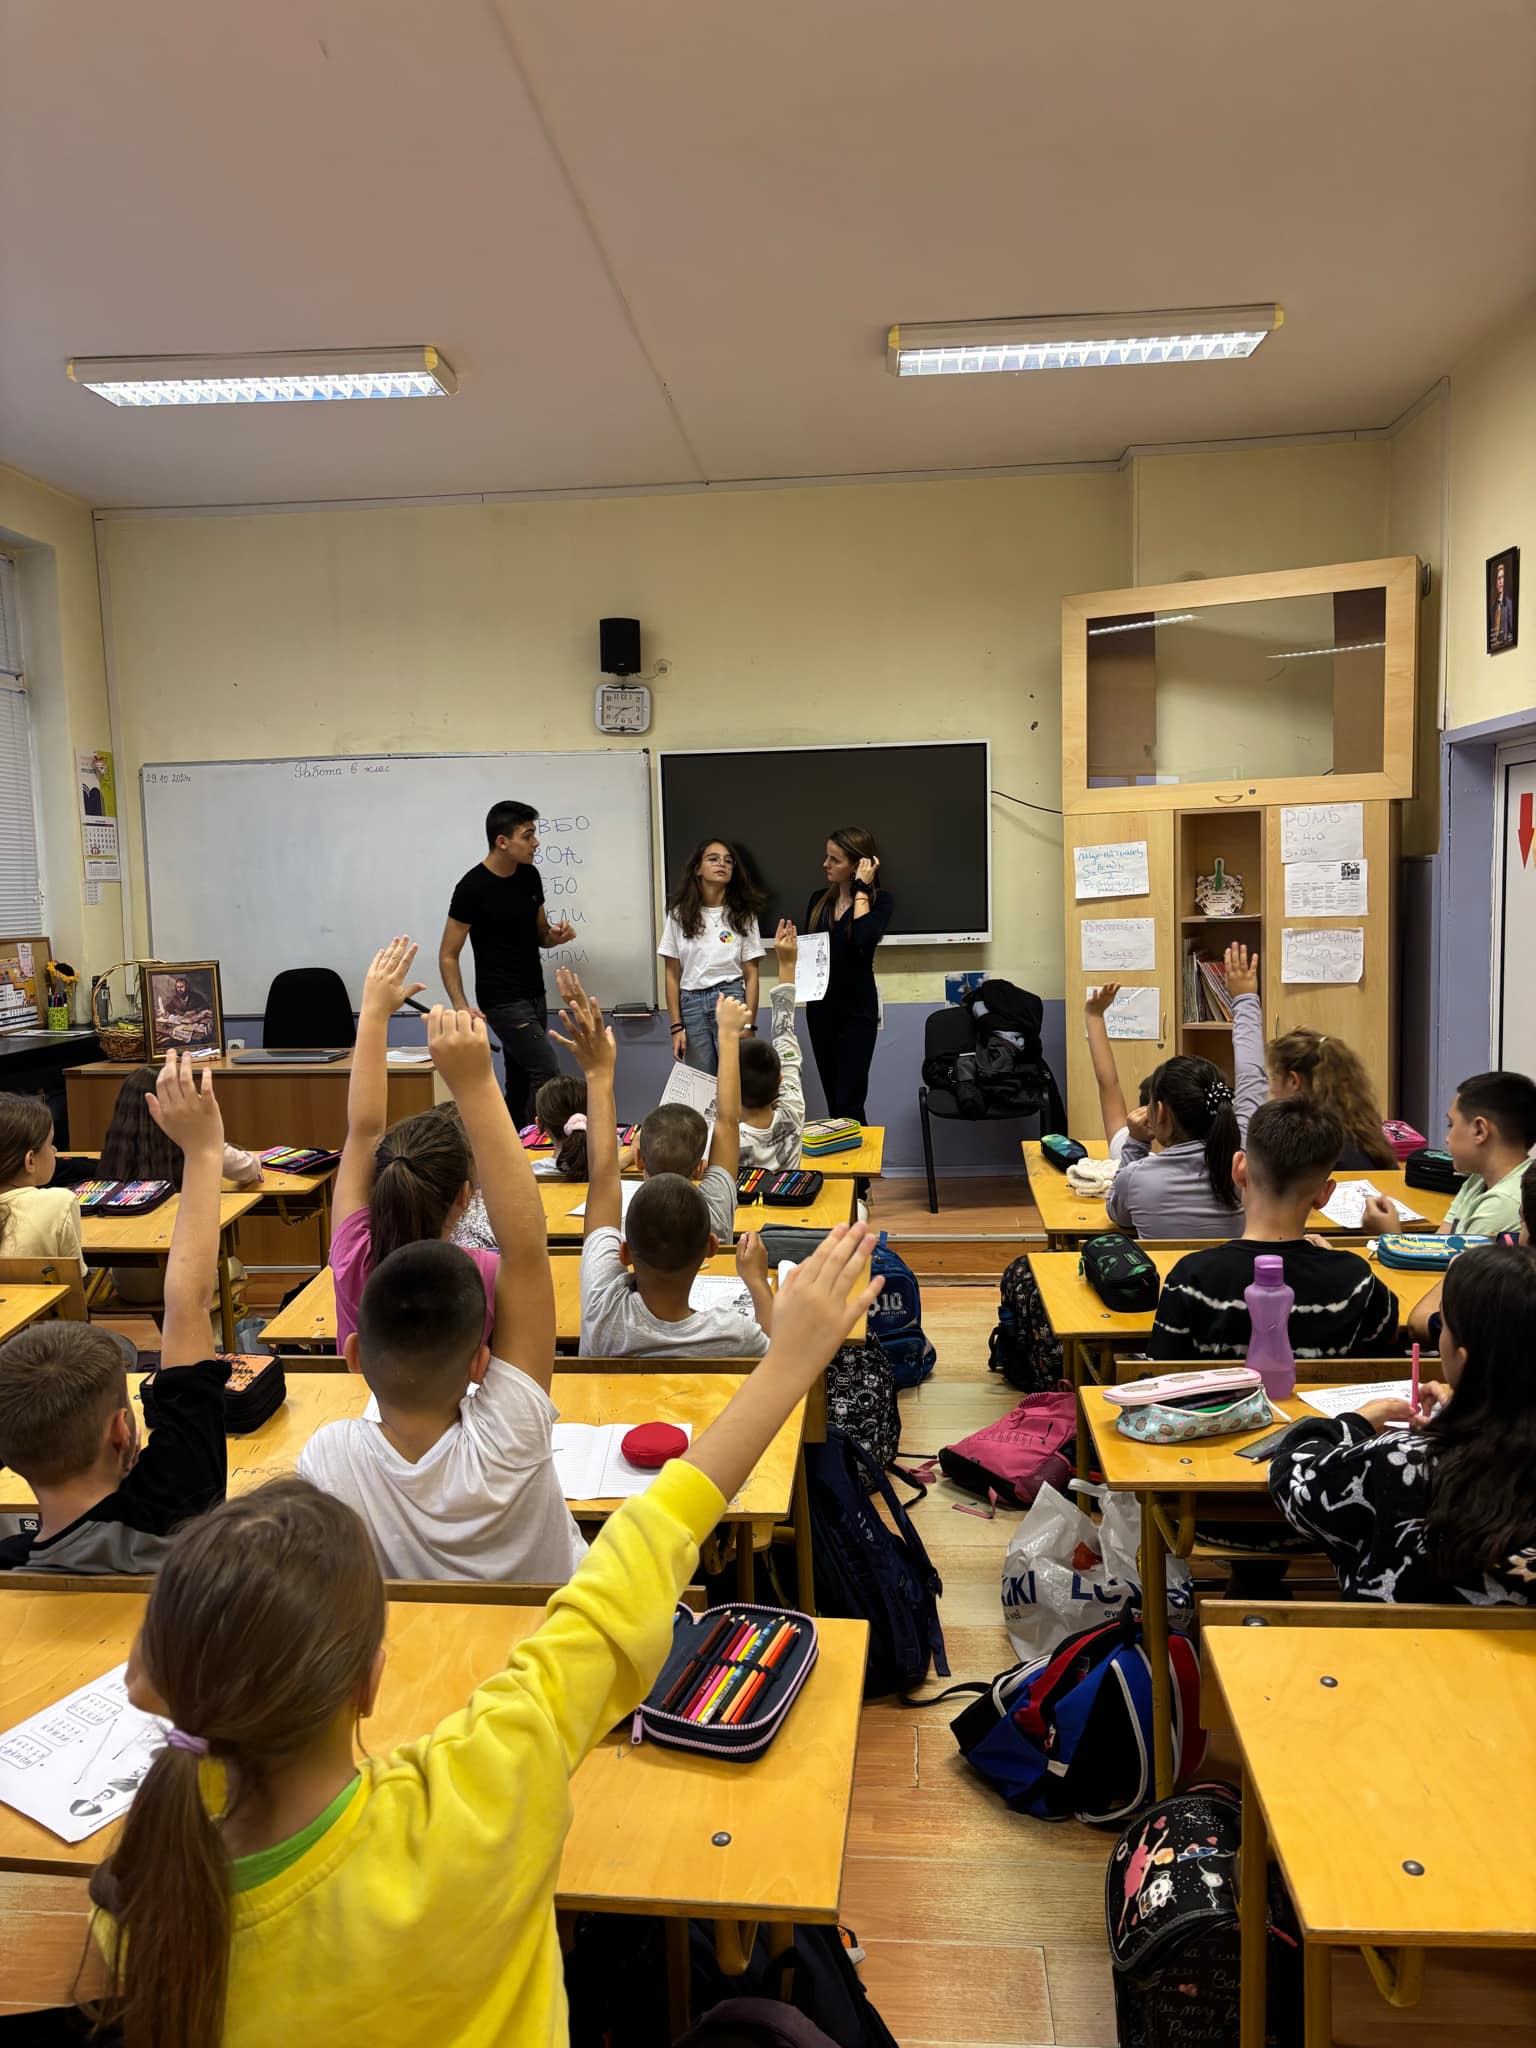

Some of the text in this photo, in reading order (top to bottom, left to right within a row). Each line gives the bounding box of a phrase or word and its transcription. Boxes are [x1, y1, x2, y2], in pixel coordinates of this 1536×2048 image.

[294, 762, 342, 778] Работа
[350, 762, 358, 774] в
[1285, 809, 1342, 827] РОМБ
[881, 1292, 903, 1311] 10
